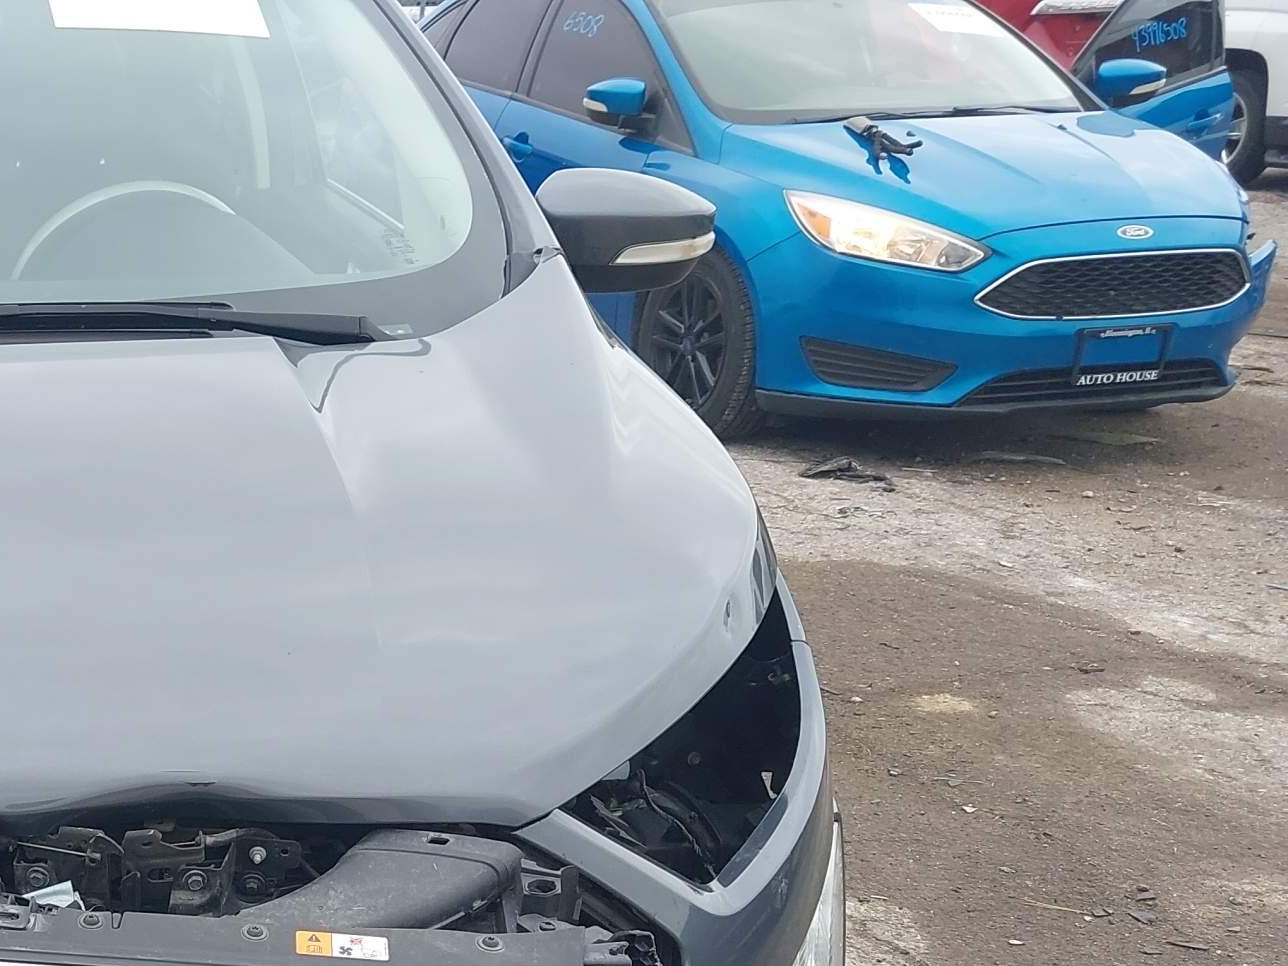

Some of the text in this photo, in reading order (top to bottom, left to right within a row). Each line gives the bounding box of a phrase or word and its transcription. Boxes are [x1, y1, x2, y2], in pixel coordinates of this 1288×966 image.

[563, 11, 604, 37] 6508
[1132, 16, 1187, 52] 43996508
[1076, 369, 1160, 386] AUTO HOUSE
